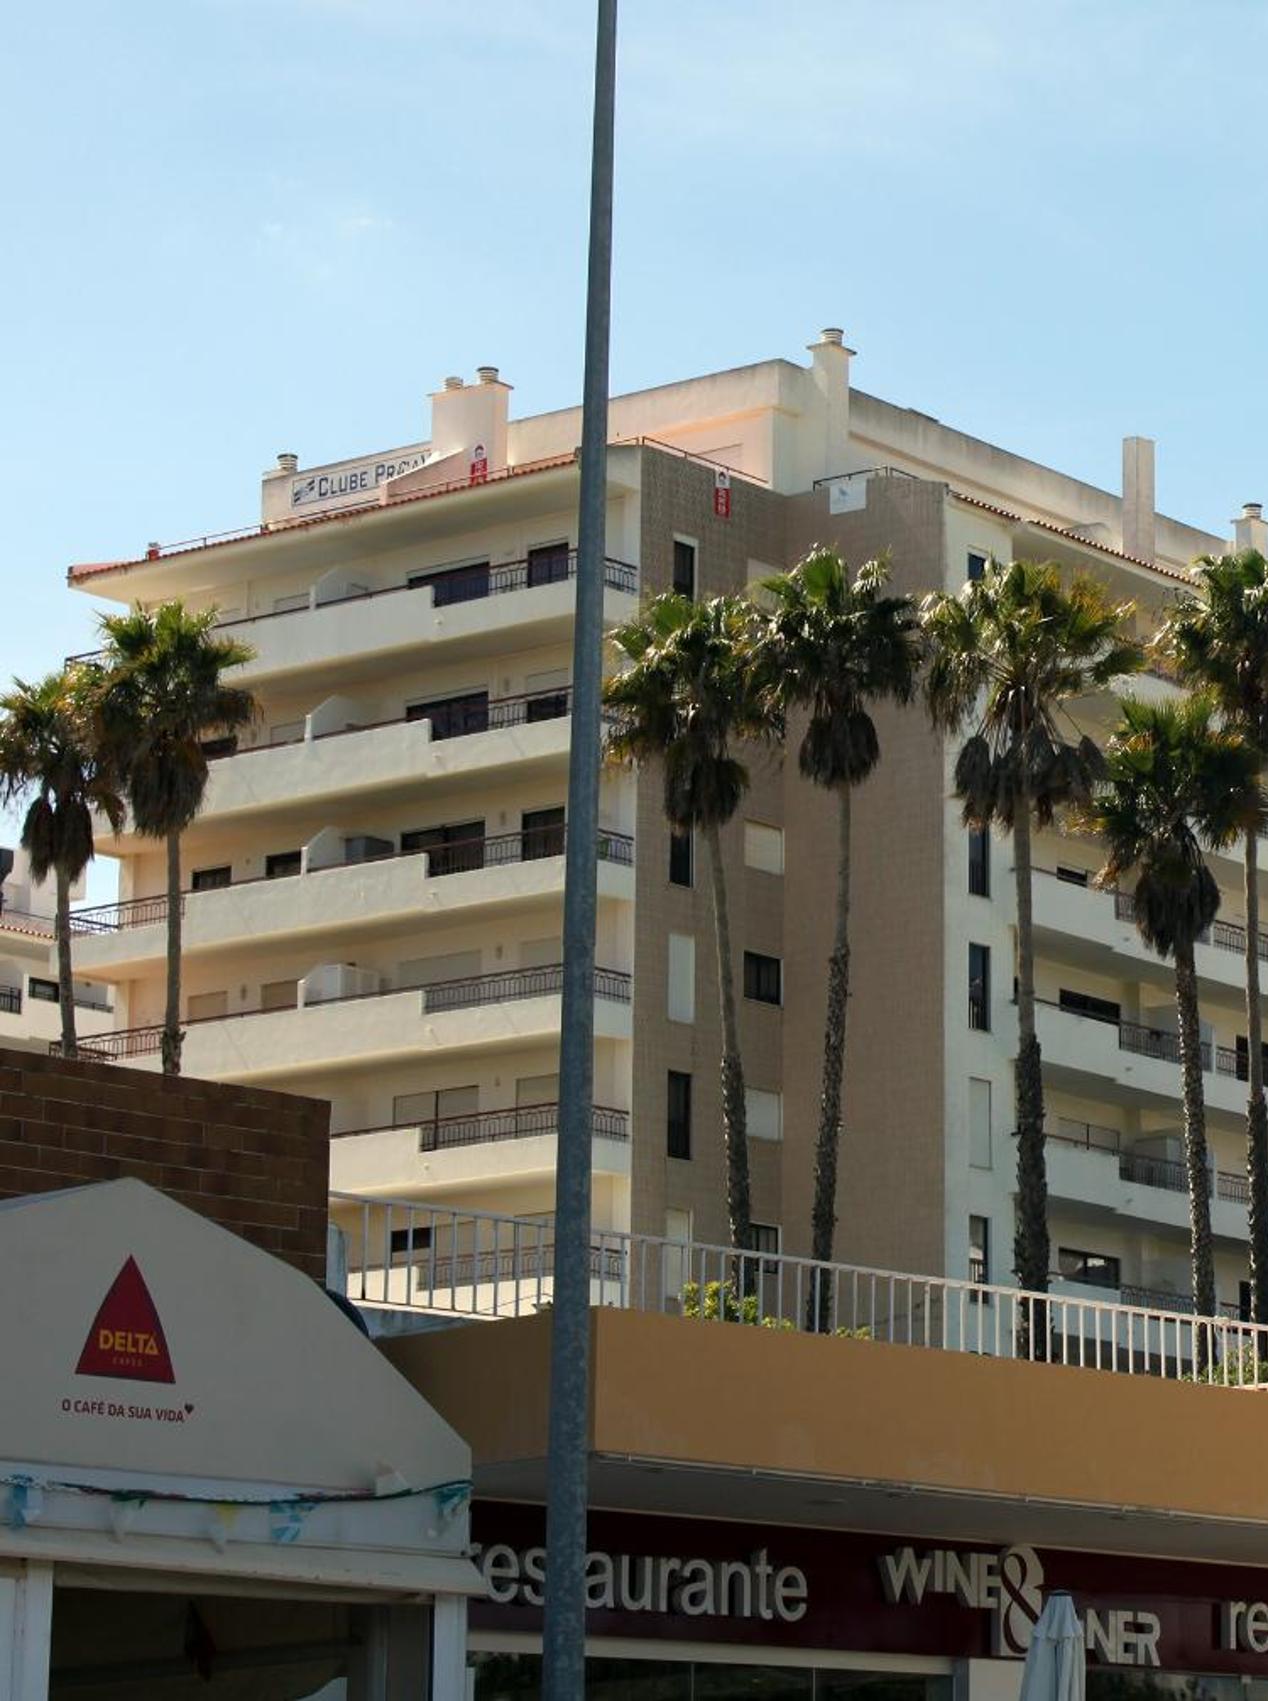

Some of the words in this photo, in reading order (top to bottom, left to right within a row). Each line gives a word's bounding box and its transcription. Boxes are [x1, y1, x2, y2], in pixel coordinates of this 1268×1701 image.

[318, 471, 368, 498] CLUBE
[98, 1328, 160, 1356] DELTA
[61, 1399, 71, 1411] O
[74, 1398, 105, 1415] CAFÉ
[108, 1403, 126, 1418] DA
[128, 1406, 152, 1420] SUA
[155, 1408, 185, 1423] VIDA
[470, 1542, 808, 1622] esaurante
[886, 1546, 1000, 1609] WINE
